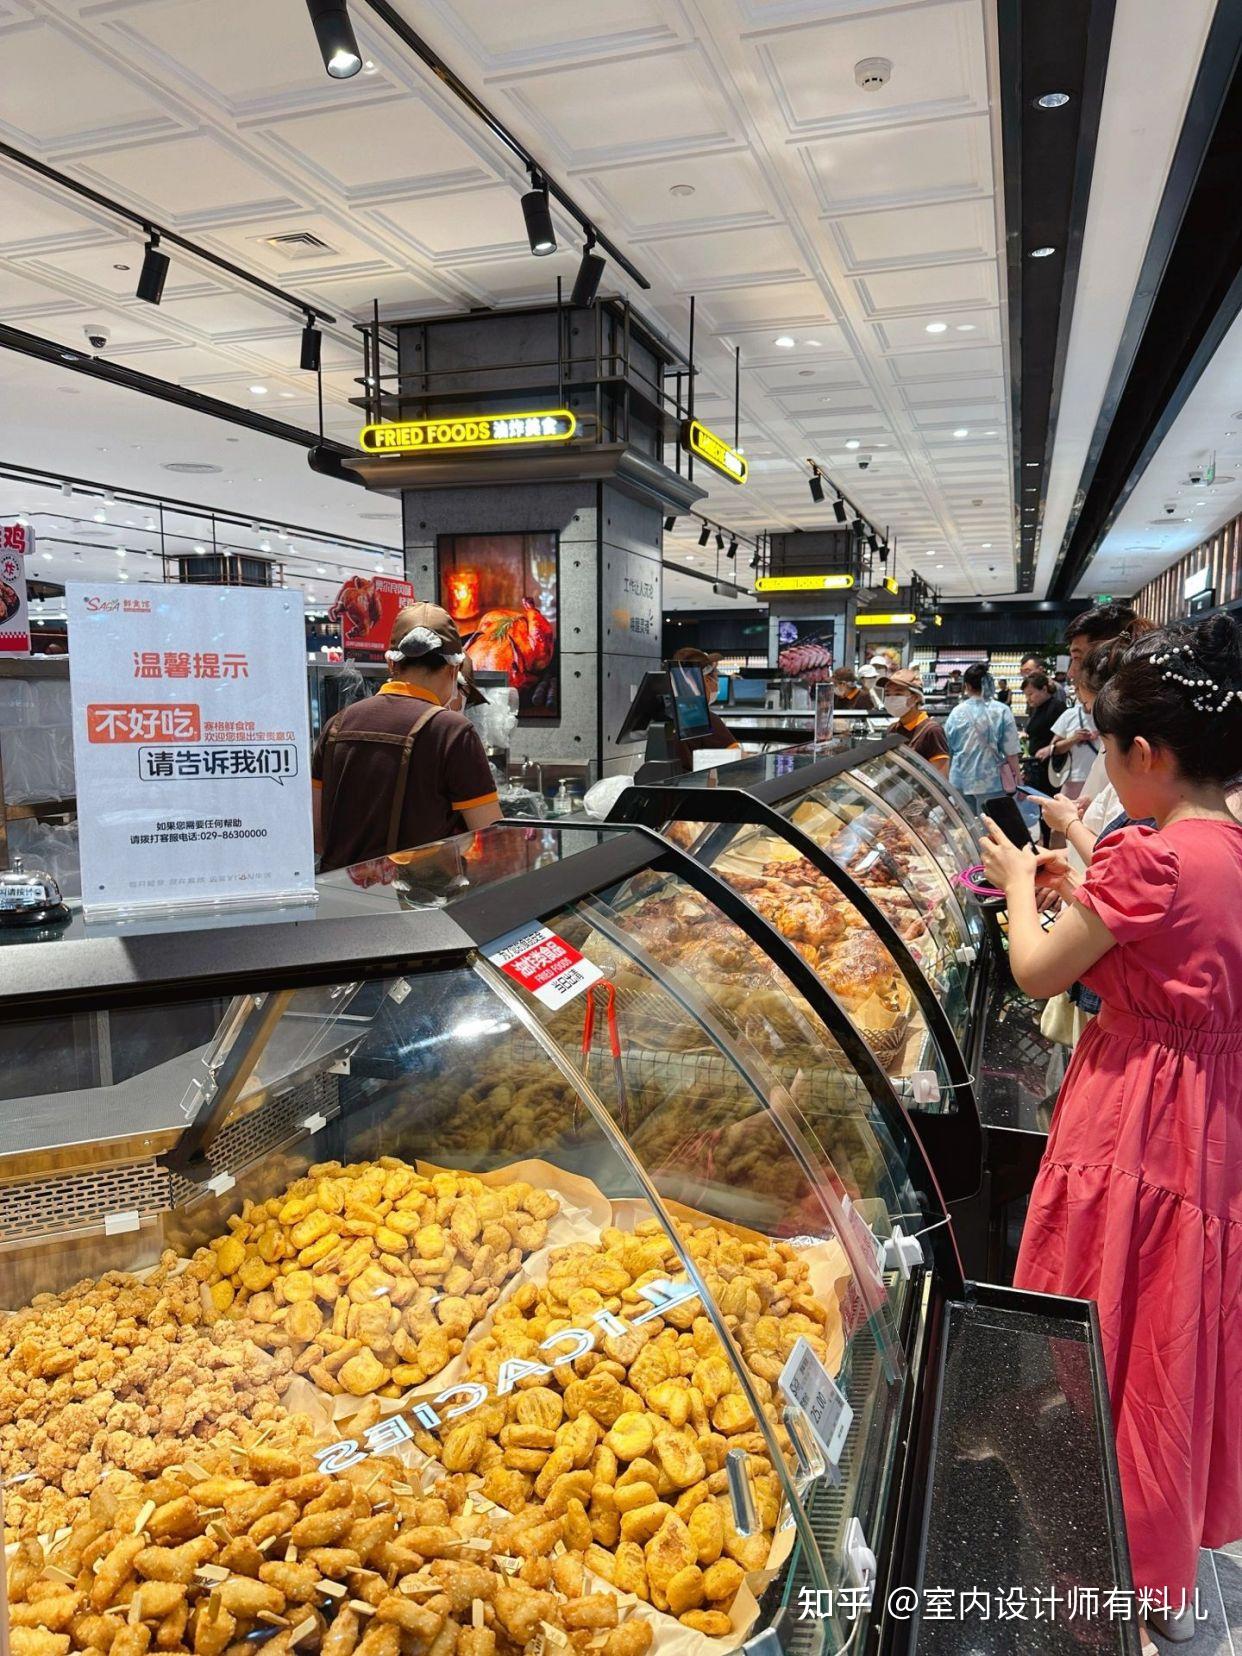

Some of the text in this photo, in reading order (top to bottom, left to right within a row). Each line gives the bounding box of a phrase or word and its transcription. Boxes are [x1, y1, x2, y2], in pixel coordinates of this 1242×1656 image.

[375, 422, 490, 447] FRIED FOODS
[133, 651, 249, 679] 温馨提示
[95, 708, 194, 740] 不好吃
[204, 721, 256, 731] 赛格鲜食馆
[205, 731, 296, 742] 欢迎您提出宝贵意见
[156, 818, 243, 832] 如果您需要任何帮助
[510, 941, 568, 978] 油炸类食品
[550, 968, 585, 994] 当日出清
